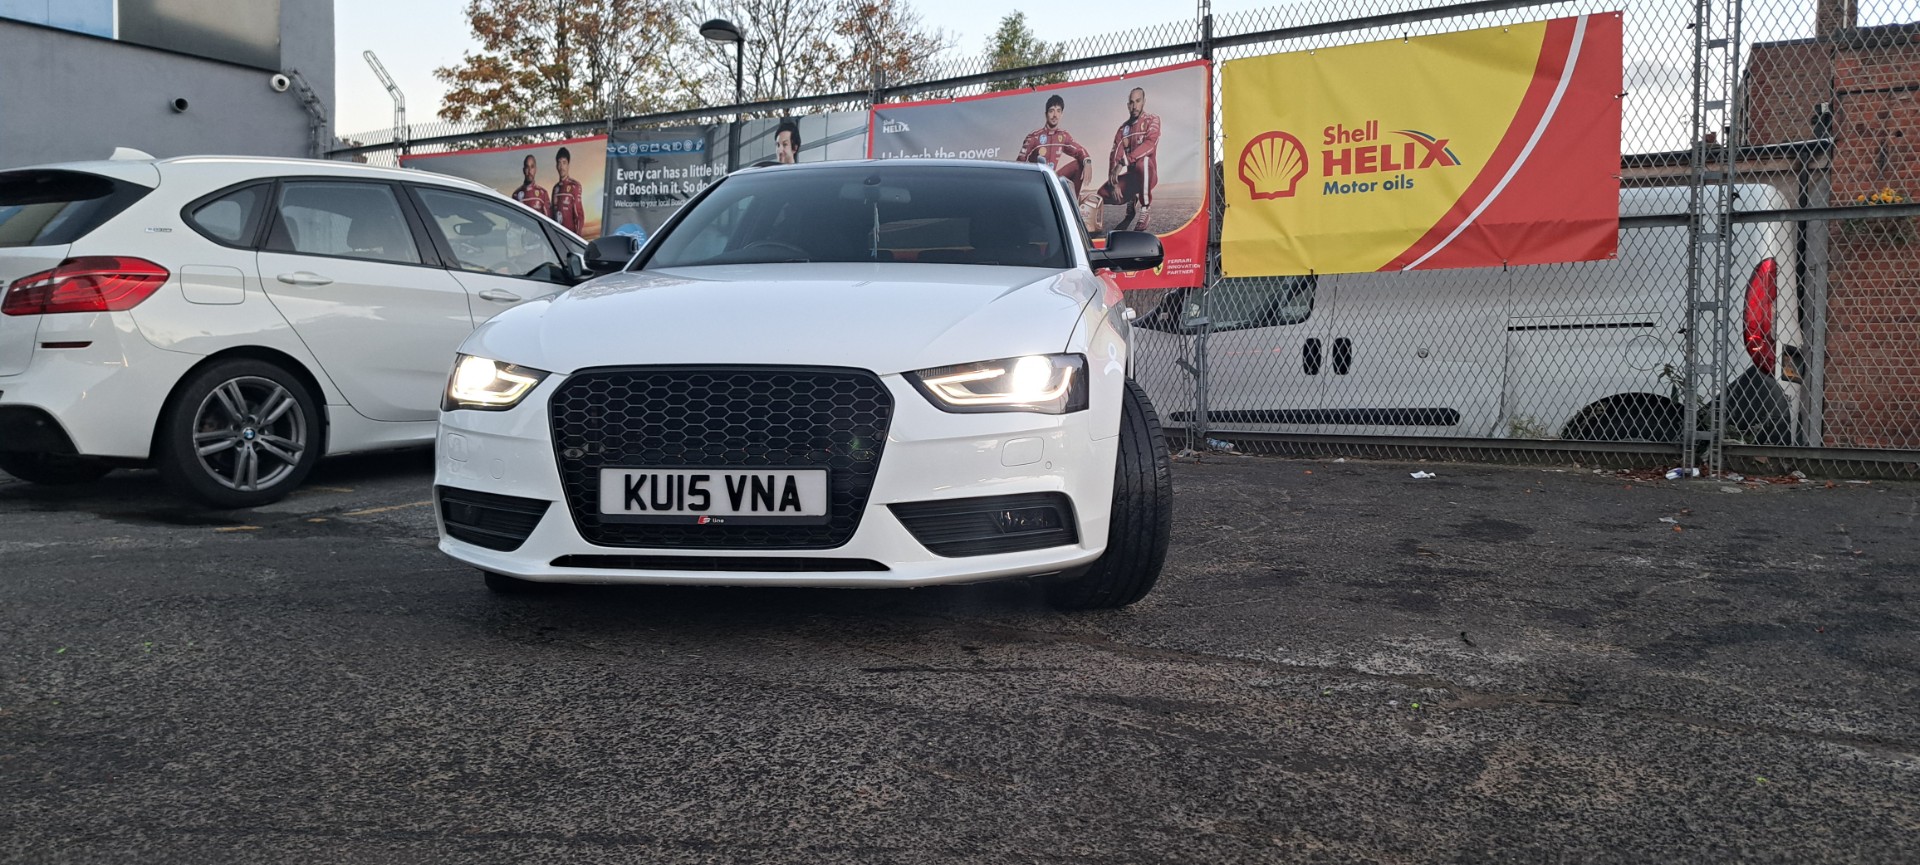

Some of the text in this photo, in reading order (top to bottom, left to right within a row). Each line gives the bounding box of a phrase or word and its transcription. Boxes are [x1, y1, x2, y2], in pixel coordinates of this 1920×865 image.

[882, 121, 910, 134] HELIX
[1323, 120, 1378, 146] Shell
[935, 146, 956, 159] the
[959, 147, 1000, 159] power
[1321, 130, 1461, 177] HELIX
[616, 162, 728, 183] Every car has a little bit
[615, 182, 628, 196] of
[629, 181, 658, 196] Bosch
[659, 181, 669, 195] in
[671, 180, 681, 194] it.
[682, 180, 696, 193] So
[1323, 173, 1414, 195] Motor oils
[614, 199, 640, 208] Welcome
[646, 200, 658, 208] your
[624, 474, 802, 512] KU15 VNA
